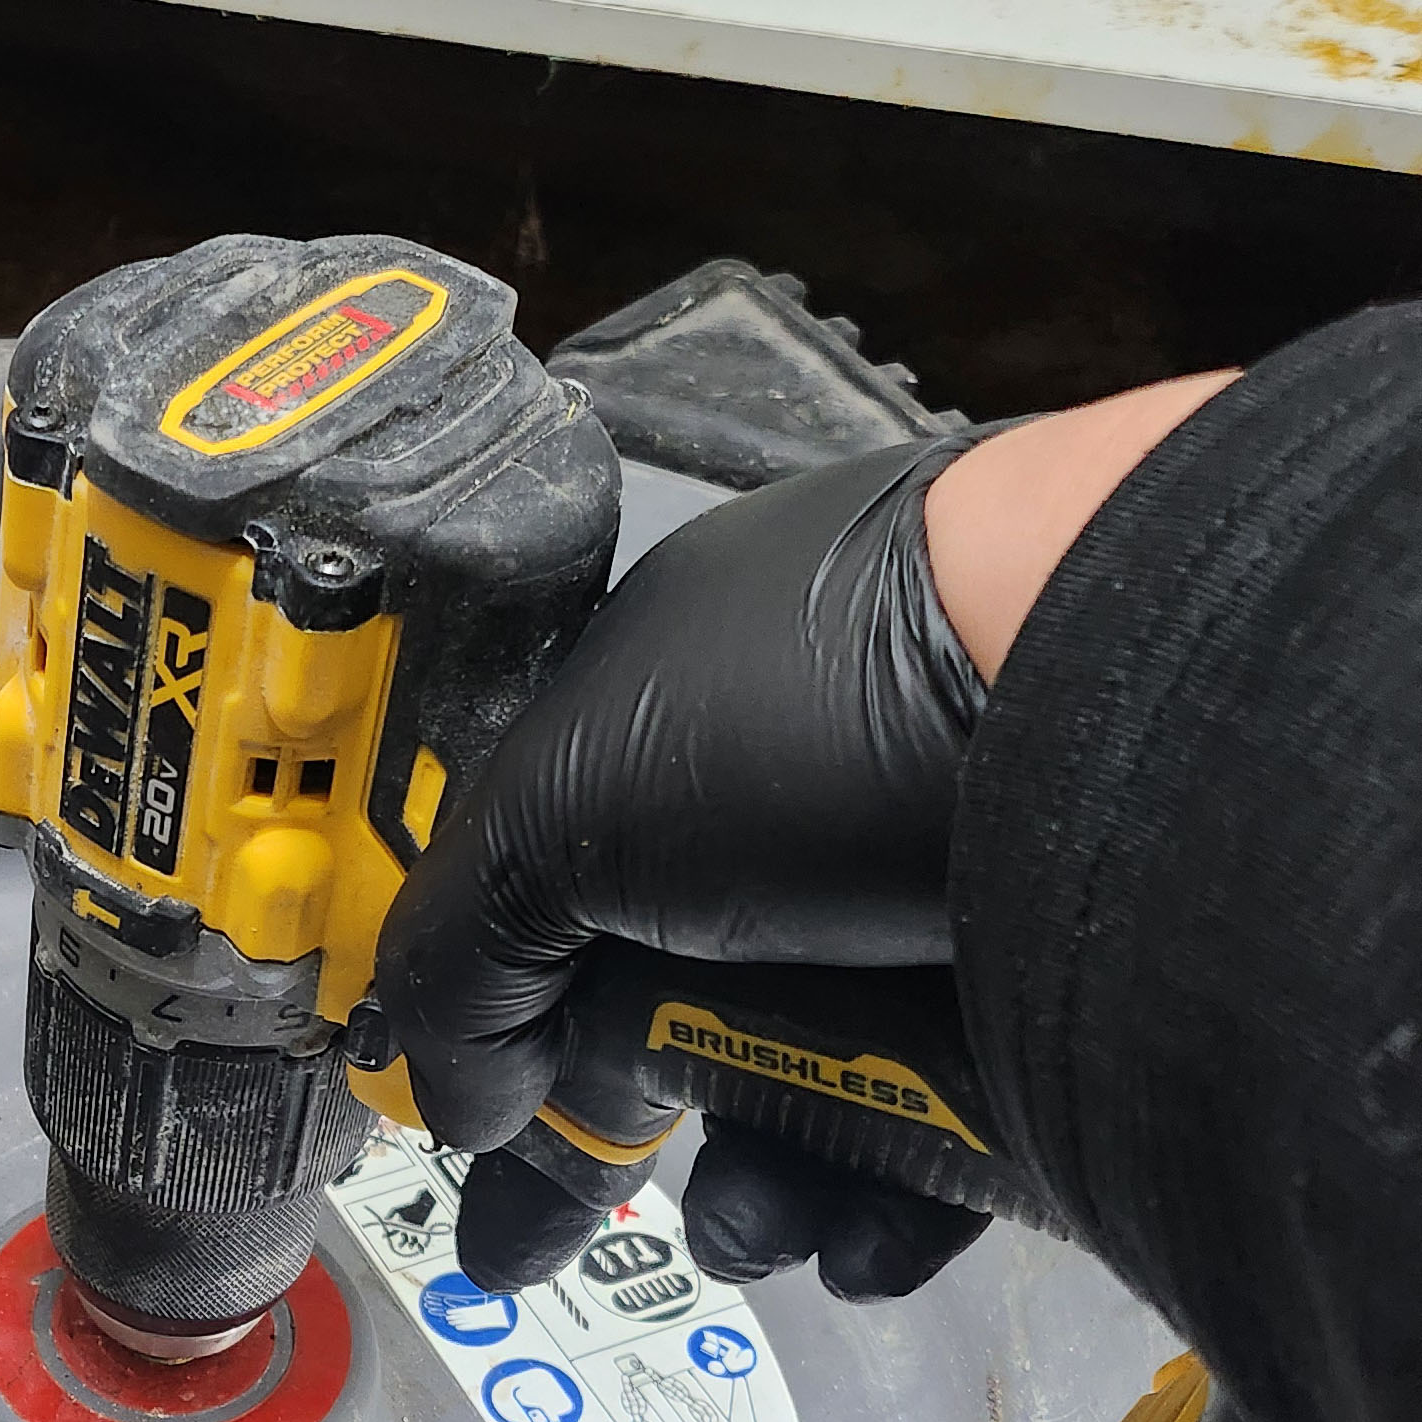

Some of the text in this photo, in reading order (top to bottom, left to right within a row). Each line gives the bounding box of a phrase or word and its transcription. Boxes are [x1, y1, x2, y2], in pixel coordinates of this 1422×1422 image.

[235, 313, 347, 387] PERFORM
[255, 323, 363, 399] PROTECT
[59, 534, 144, 855] DEWALT
[151, 617, 209, 731] XR
[668, 1018, 929, 1115] BRUSHLESS
